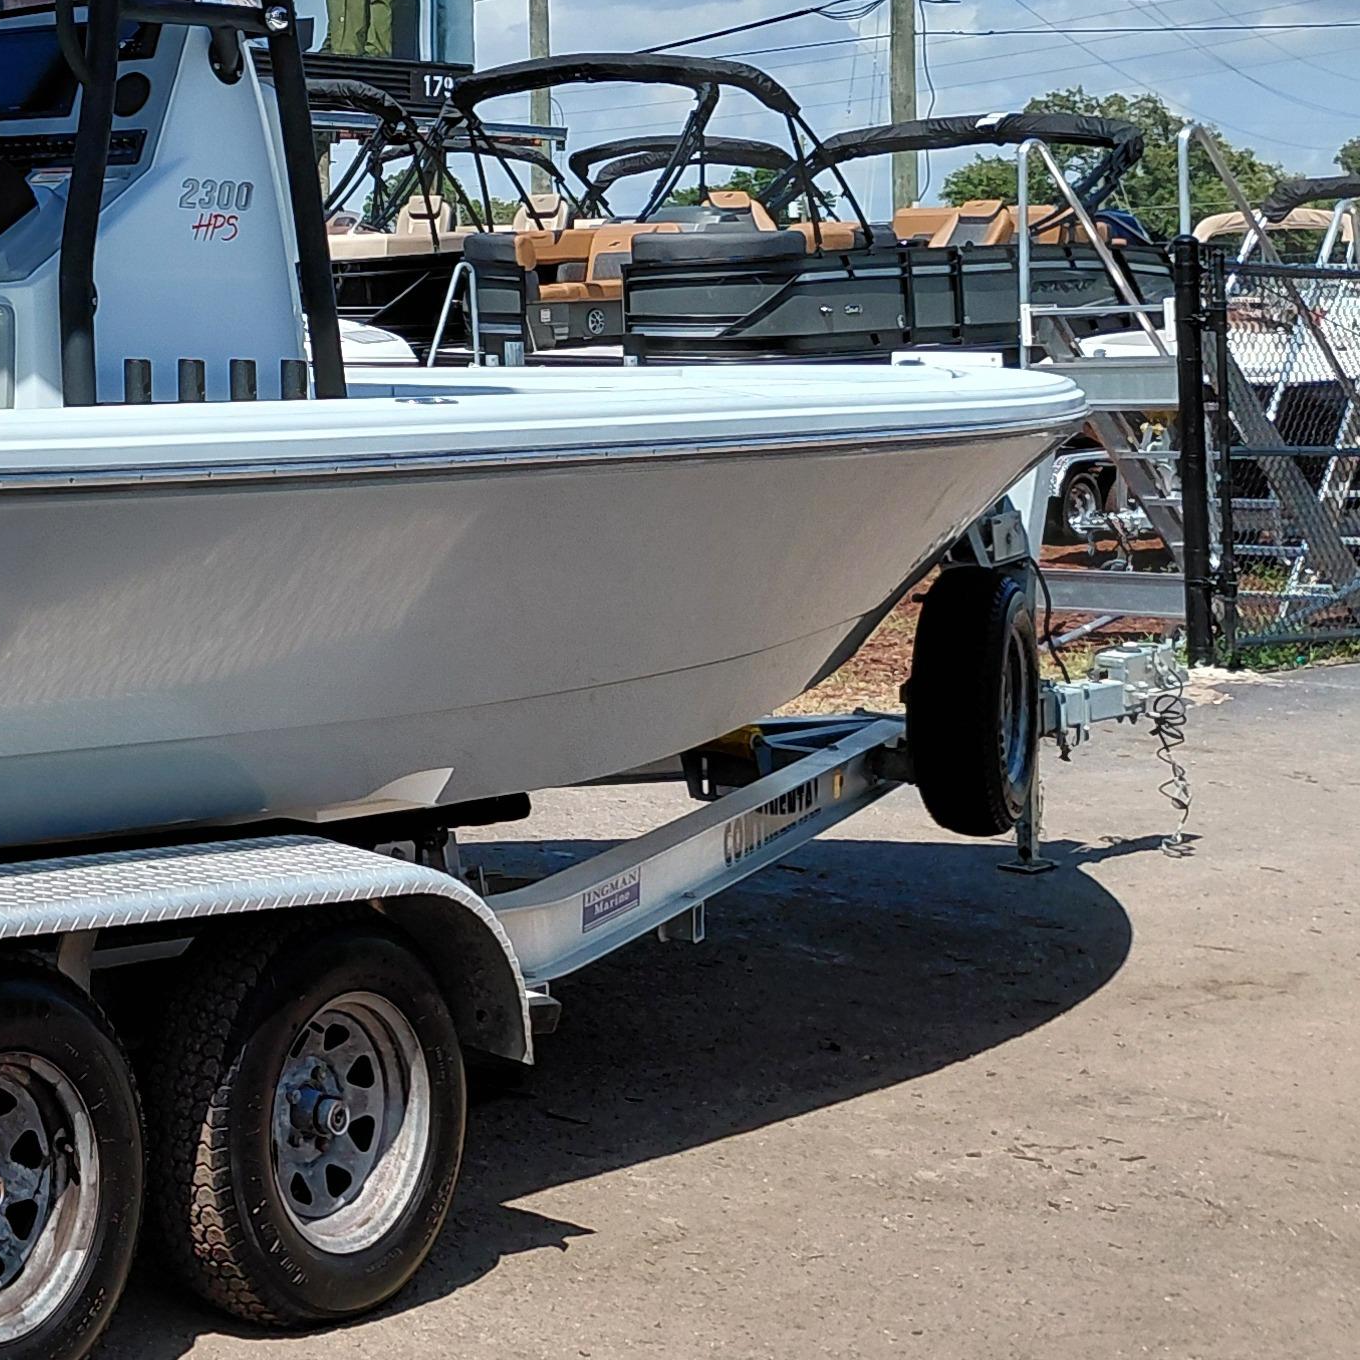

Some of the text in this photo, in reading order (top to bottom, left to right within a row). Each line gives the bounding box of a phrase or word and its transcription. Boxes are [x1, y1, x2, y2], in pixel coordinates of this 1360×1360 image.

[423, 74, 455, 98] 179
[178, 177, 255, 211] 2300
[191, 212, 239, 242] HPS
[585, 870, 638, 904] INGMAN
[593, 891, 631, 916] Marine
